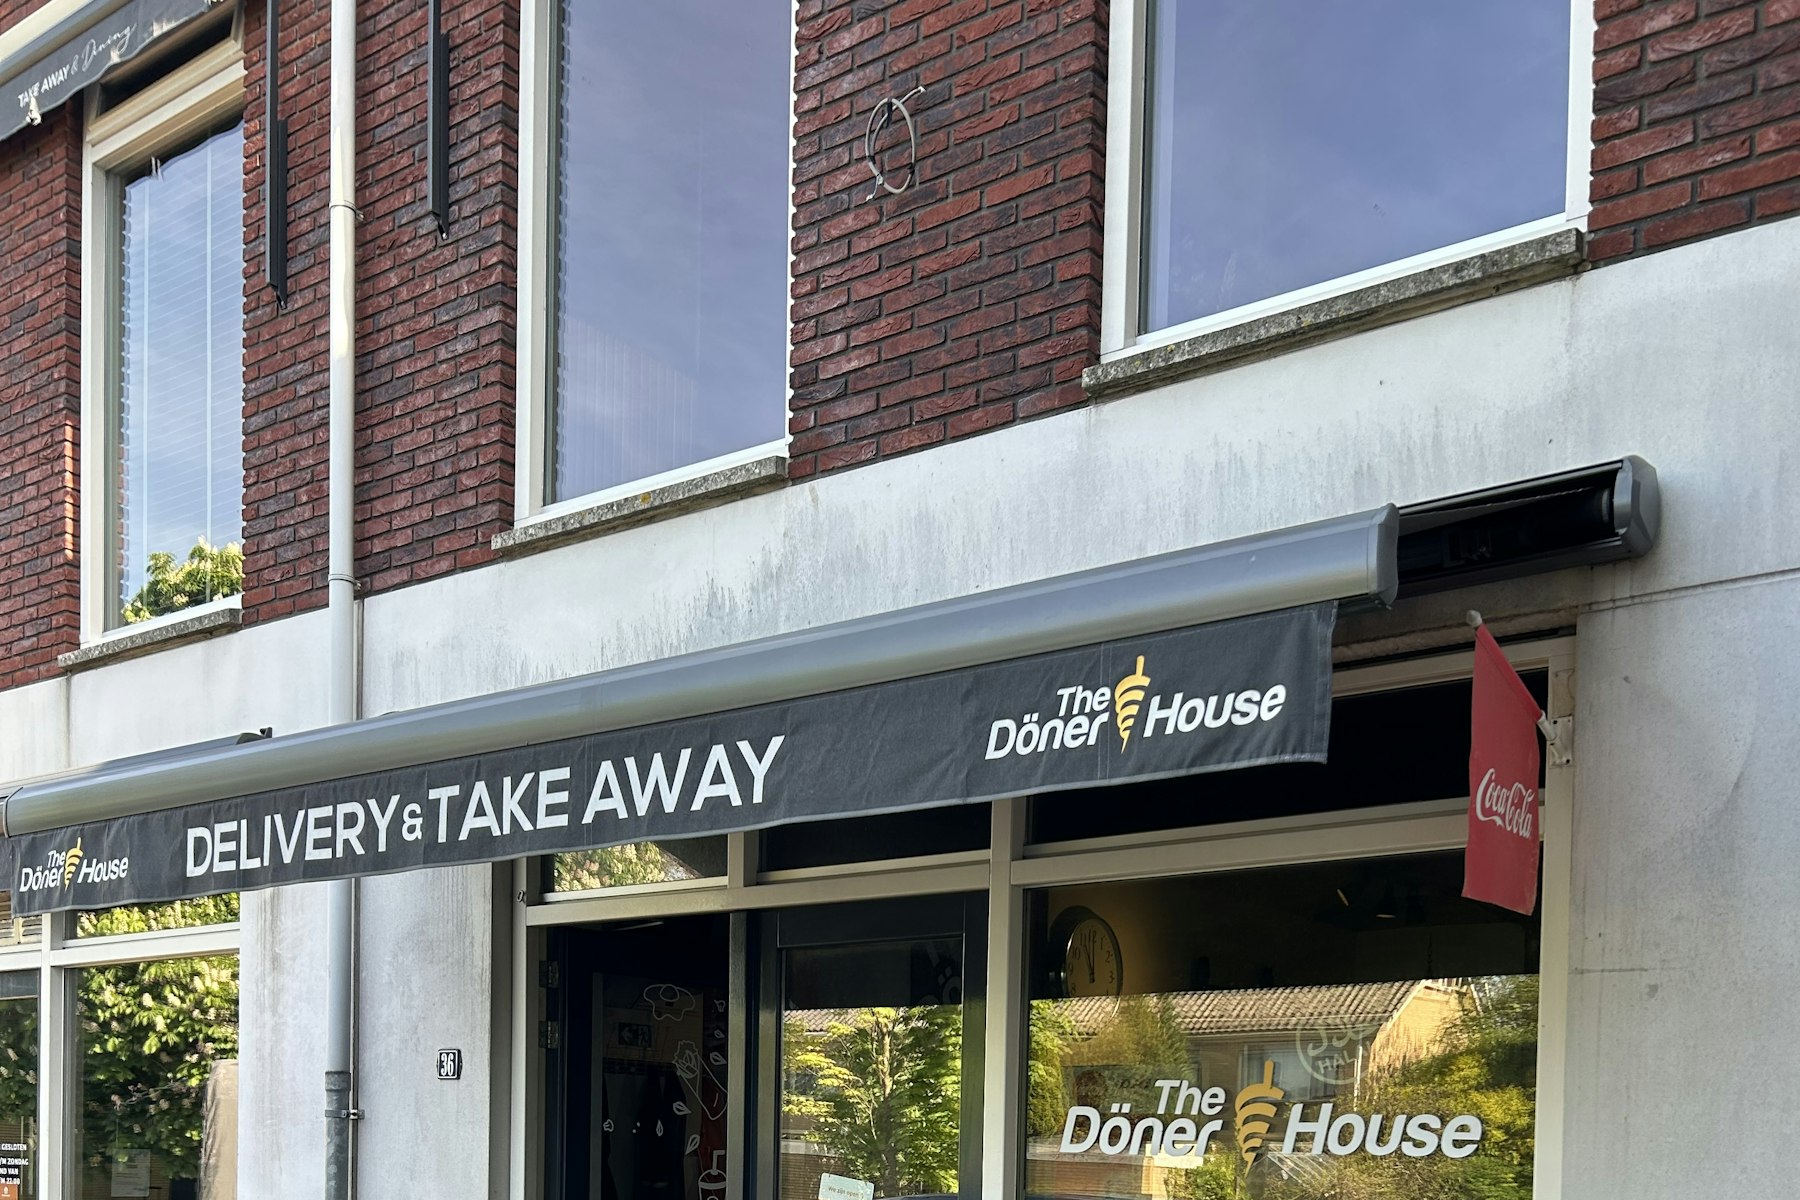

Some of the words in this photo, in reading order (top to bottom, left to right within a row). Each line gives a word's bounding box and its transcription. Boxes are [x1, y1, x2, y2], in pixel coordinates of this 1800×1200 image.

[17, 85, 40, 108] TAKE
[41, 64, 70, 94] AWAY
[1057, 685, 1111, 717] The
[984, 711, 1110, 760] Döner
[1143, 684, 1287, 738] House
[186, 794, 401, 878] DELIVERY
[401, 802, 423, 841] &
[428, 766, 571, 844] TAKE
[581, 735, 785, 825] AWAY
[19, 865, 65, 892] Döner
[77, 856, 129, 884] House
[47, 849, 66, 867] The
[441, 1053, 454, 1076] 36
[1154, 1079, 1226, 1116] The
[1, 1143, 27, 1151] GESLOTEN
[1059, 1103, 1225, 1157] Döner
[1282, 1102, 1483, 1159] House
[7, 1157, 29, 1166] ZONDAG
